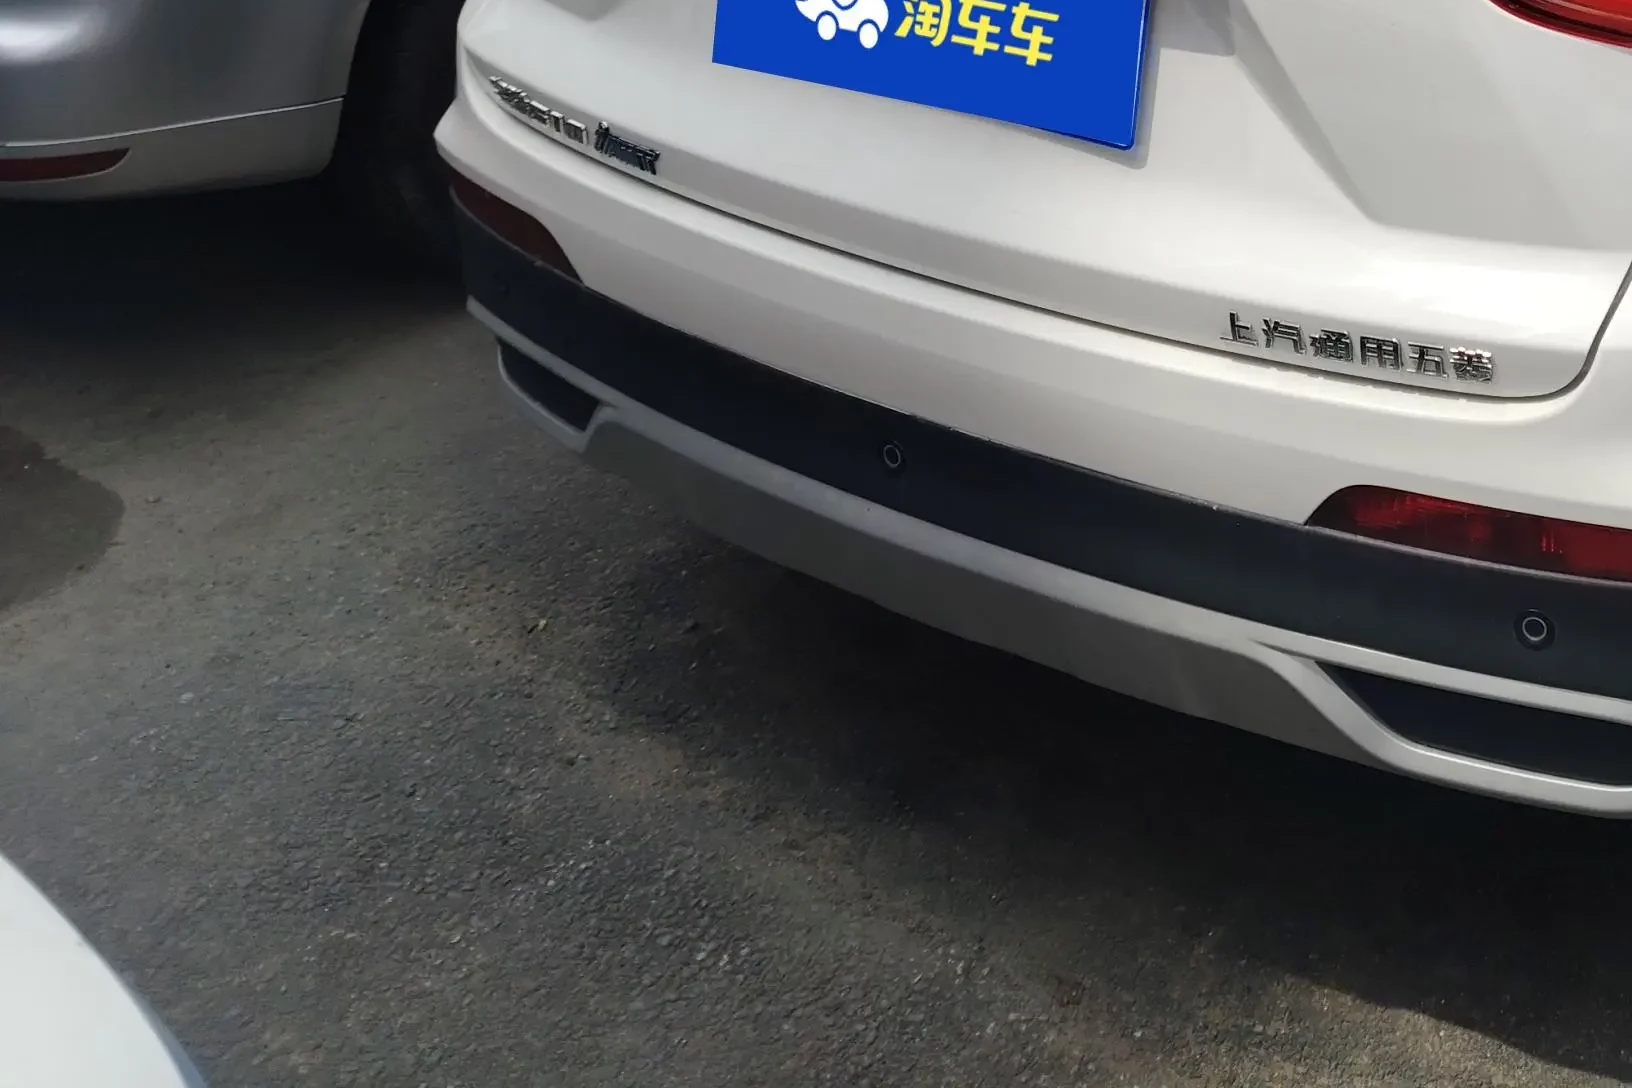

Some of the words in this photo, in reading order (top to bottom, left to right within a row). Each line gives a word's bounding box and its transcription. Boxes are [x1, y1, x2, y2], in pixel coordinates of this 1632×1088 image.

[1219, 310, 1494, 384] 上汽通用五菱
